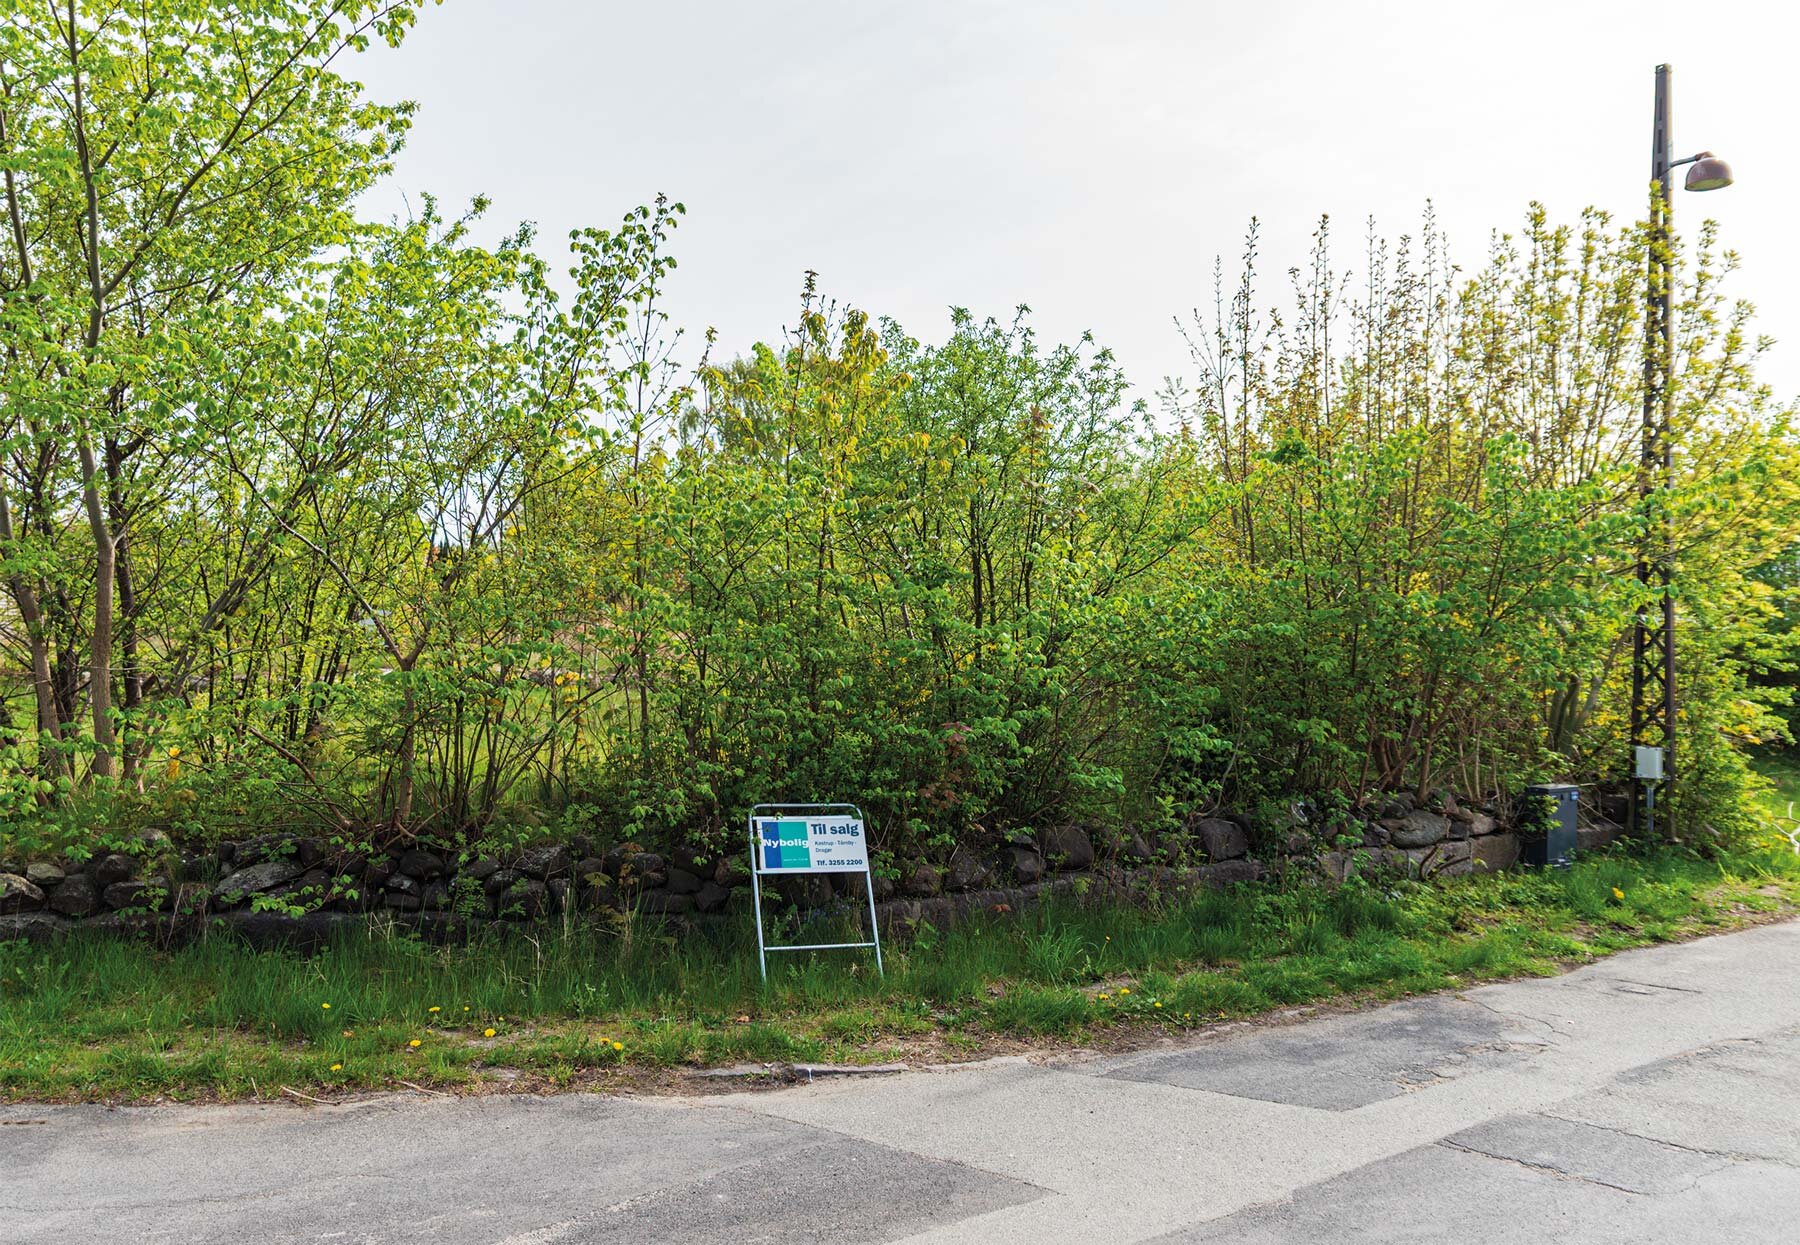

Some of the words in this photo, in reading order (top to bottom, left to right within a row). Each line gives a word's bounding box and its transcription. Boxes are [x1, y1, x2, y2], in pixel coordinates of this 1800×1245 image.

[811, 823, 827, 835] Til
[830, 823, 860, 837] salg
[763, 838, 809, 848] Nybolig
